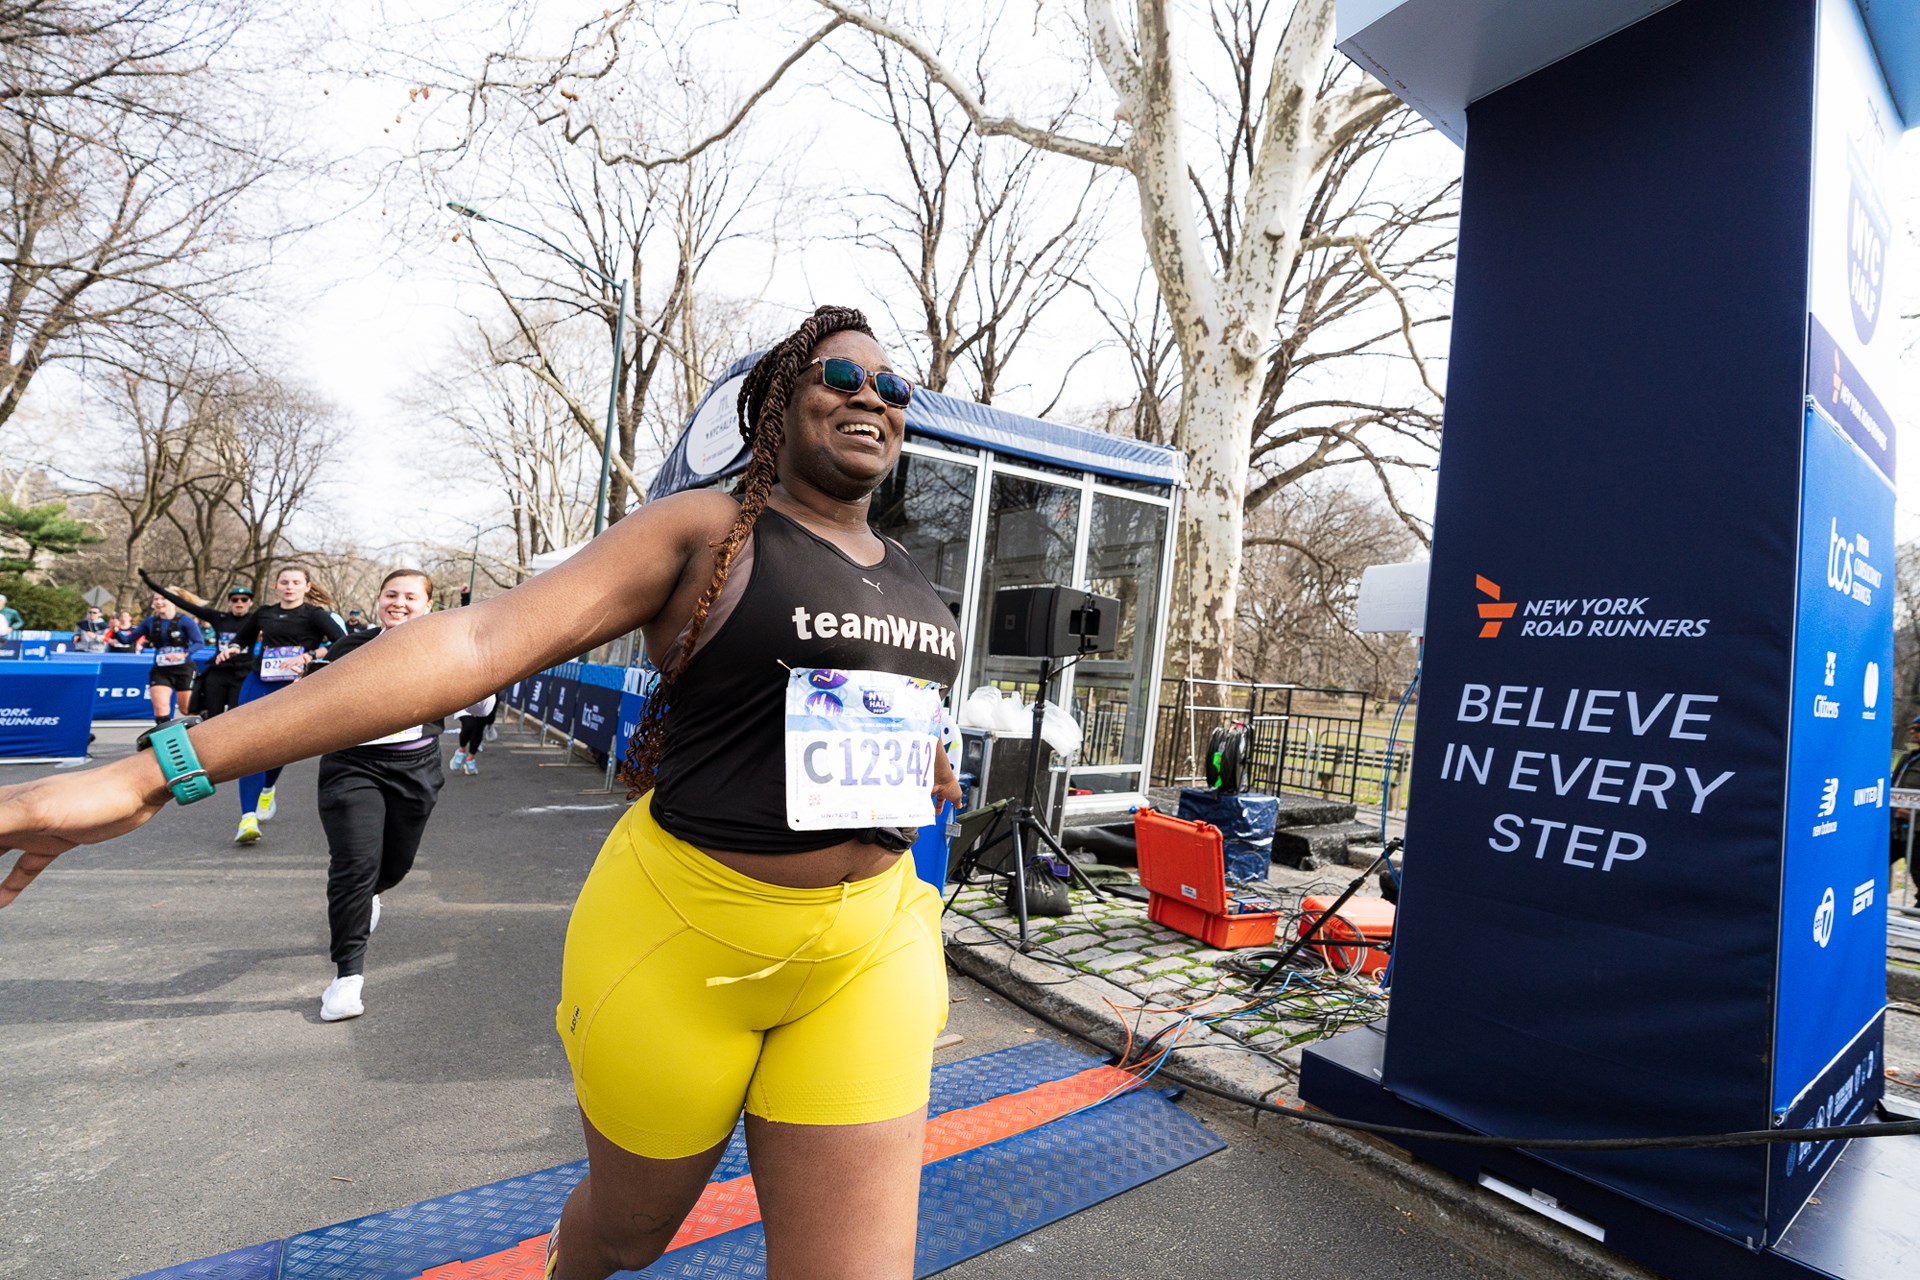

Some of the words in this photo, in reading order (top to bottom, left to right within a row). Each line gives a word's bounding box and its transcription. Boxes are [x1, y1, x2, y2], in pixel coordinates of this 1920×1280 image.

[1851, 199, 1881, 286] NYC
[1827, 516, 1854, 595] tcs
[792, 606, 956, 661] teamWRK
[1521, 620, 1583, 637] ROAD
[1587, 618, 1711, 638] RUNNERS
[1523, 599, 1577, 616] NEW
[1581, 597, 1650, 616] YORK
[96, 687, 141, 697] TED
[868, 692, 890, 701] NYC
[1456, 683, 1720, 741] BELIEVE
[1440, 743, 1495, 785] IN
[1508, 750, 1736, 814] EVERY
[1488, 813, 1648, 872] STEP
